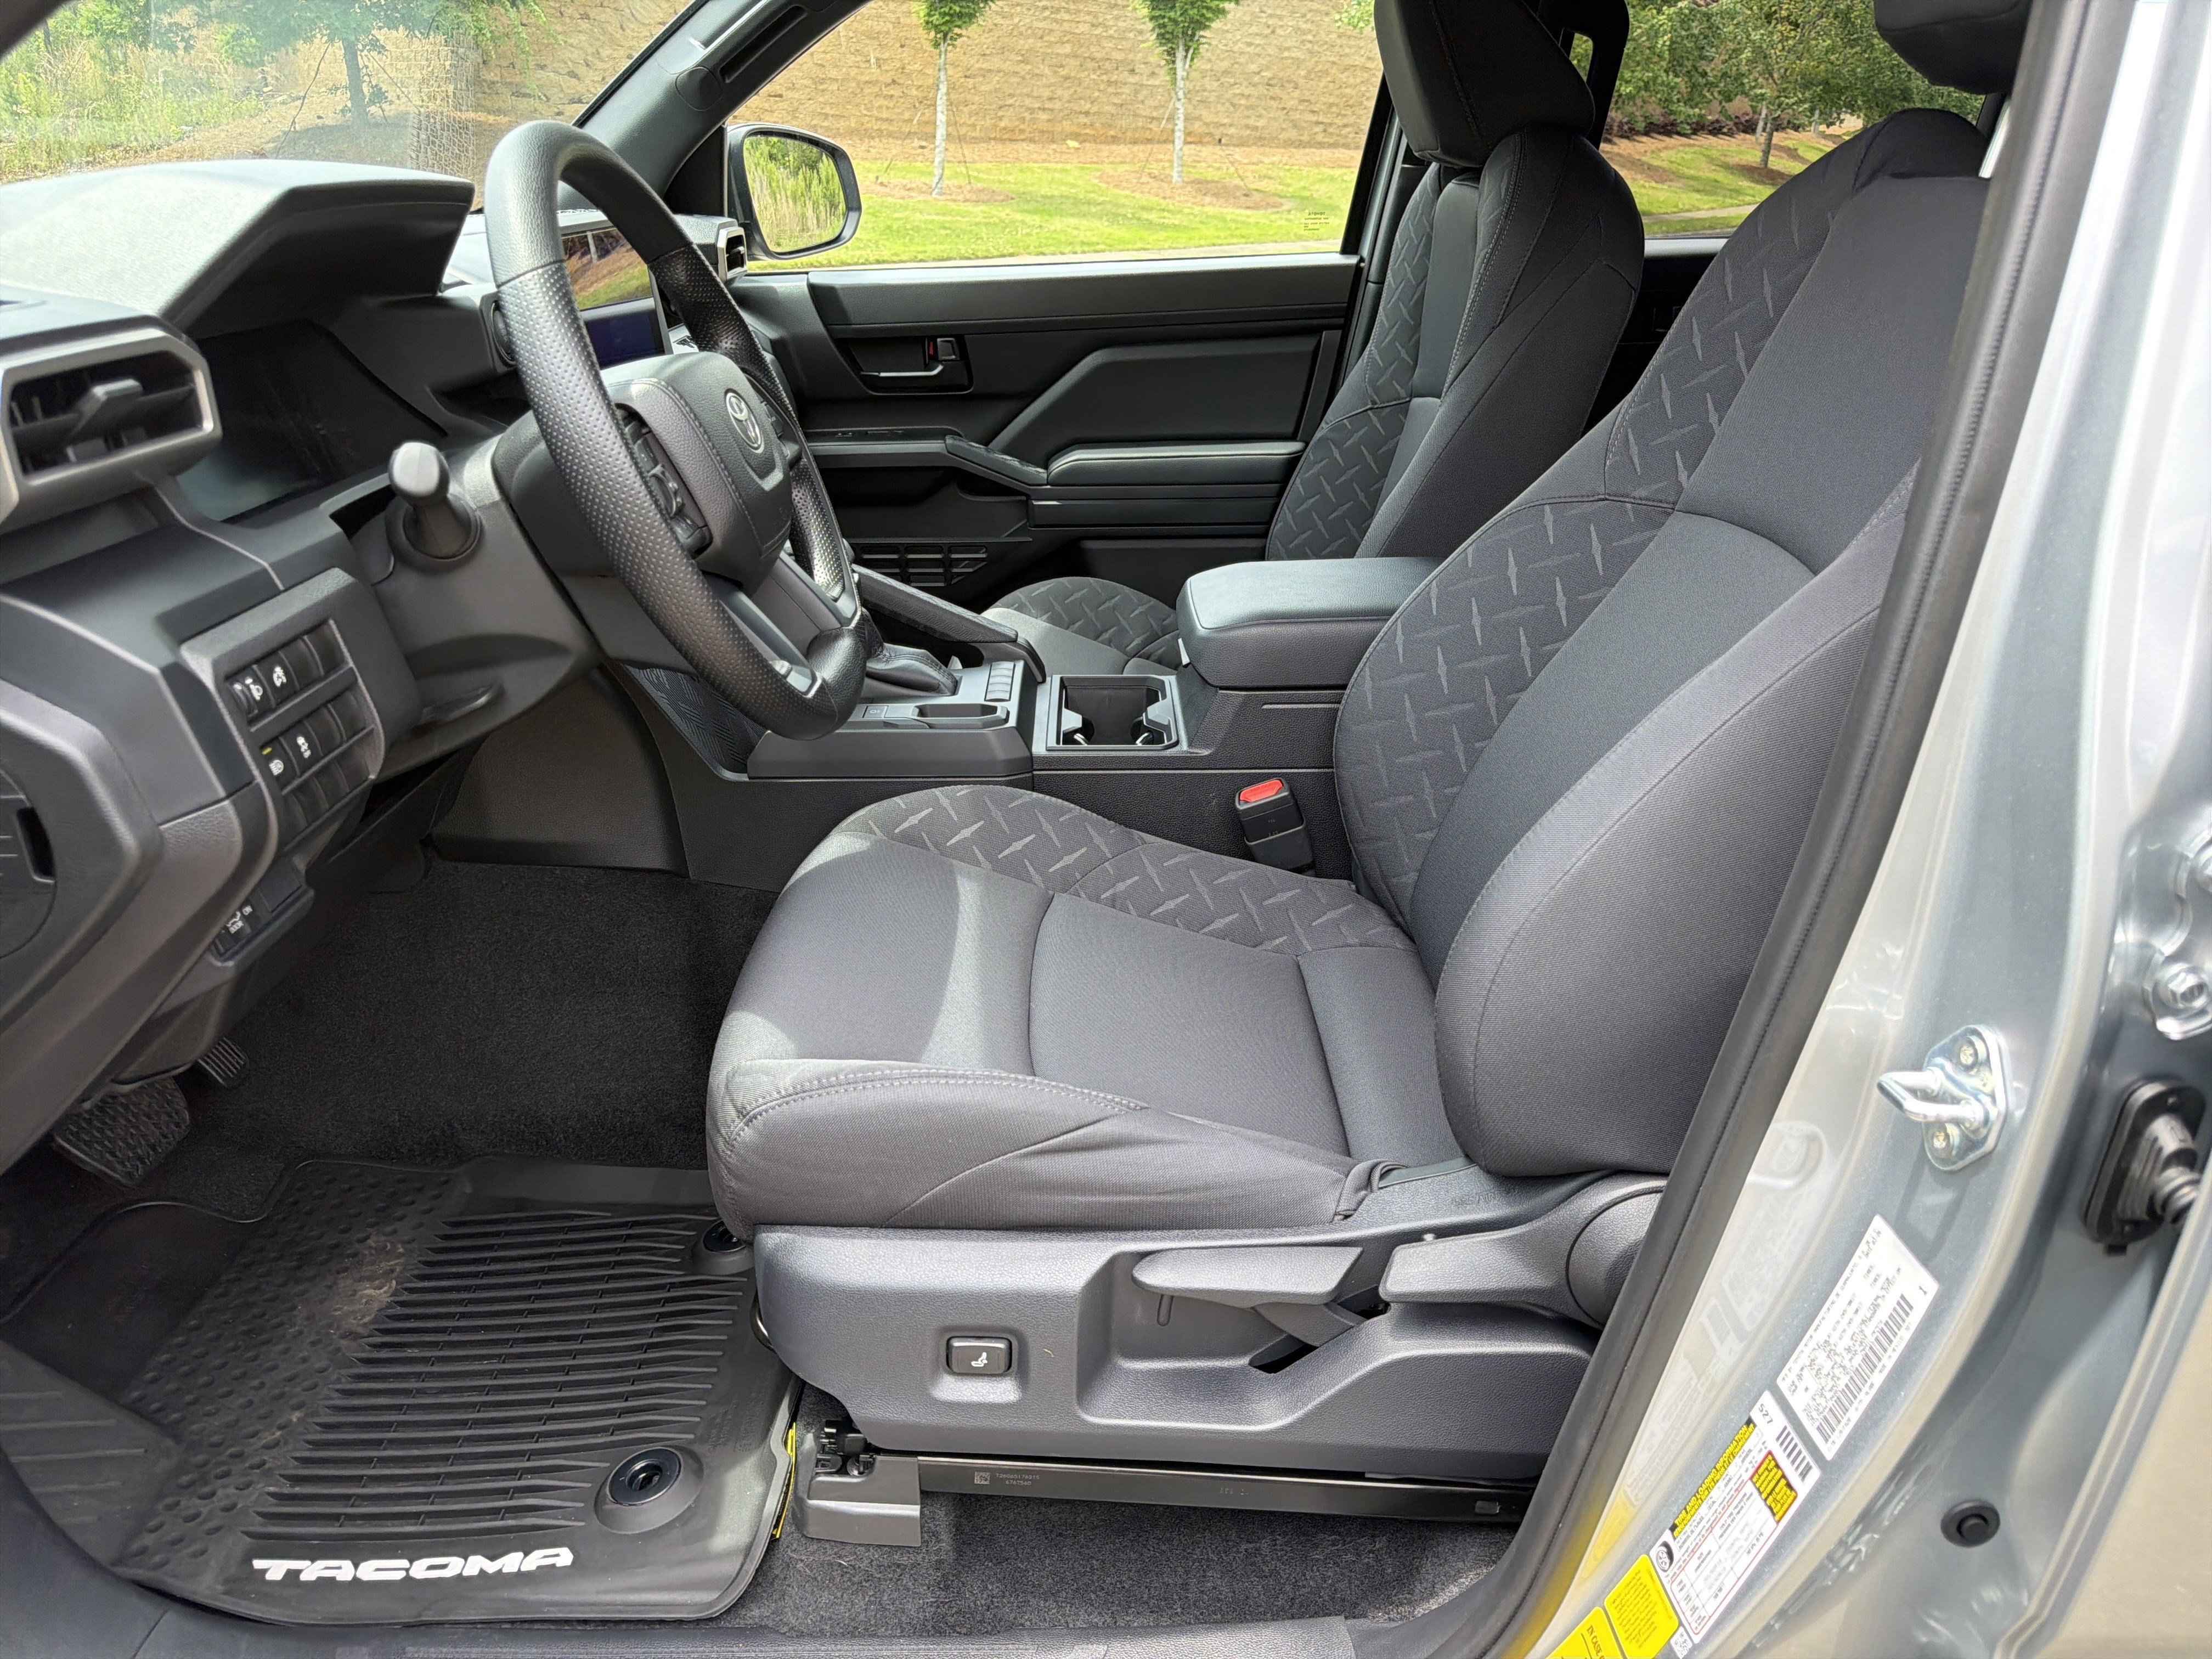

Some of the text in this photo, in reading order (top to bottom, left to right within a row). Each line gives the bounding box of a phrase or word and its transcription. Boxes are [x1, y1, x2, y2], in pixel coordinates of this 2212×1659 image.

[1476, 1190, 1510, 1205] AIRB
[1758, 1403, 1773, 1424] 527
[1674, 1424, 1748, 1527] TIRE AND LOADING INFORMATION
[252, 1547, 574, 1581] TACOMA
[1587, 1625, 1595, 1637] IN
[1592, 1635, 1602, 1656] CASE
